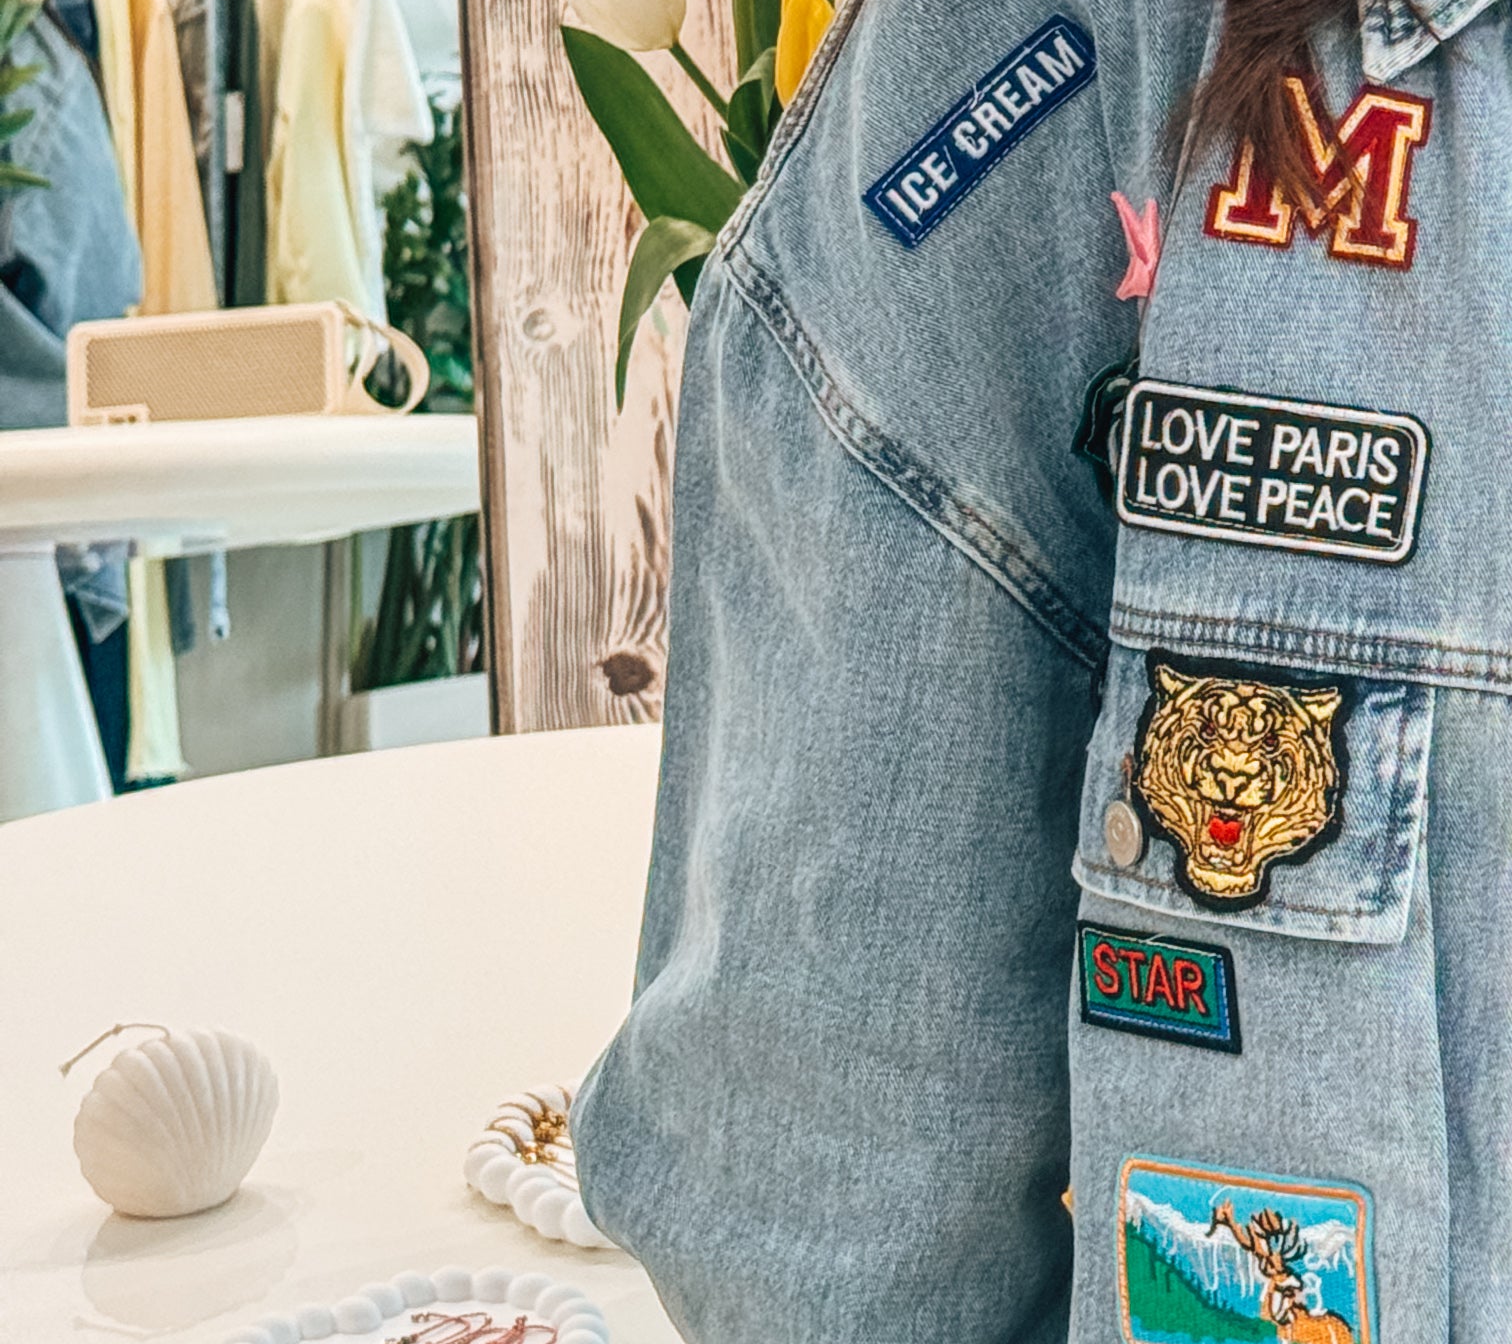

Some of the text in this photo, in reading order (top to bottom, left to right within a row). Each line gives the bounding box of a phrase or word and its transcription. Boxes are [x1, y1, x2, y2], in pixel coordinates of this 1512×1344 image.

[885, 32, 1085, 223] ICE CREAM
[1204, 72, 1433, 270] M
[1141, 400, 1400, 485] LOVE PARIS
[1136, 456, 1398, 539] LOVE PEACE
[1091, 941, 1210, 1016] STAR
